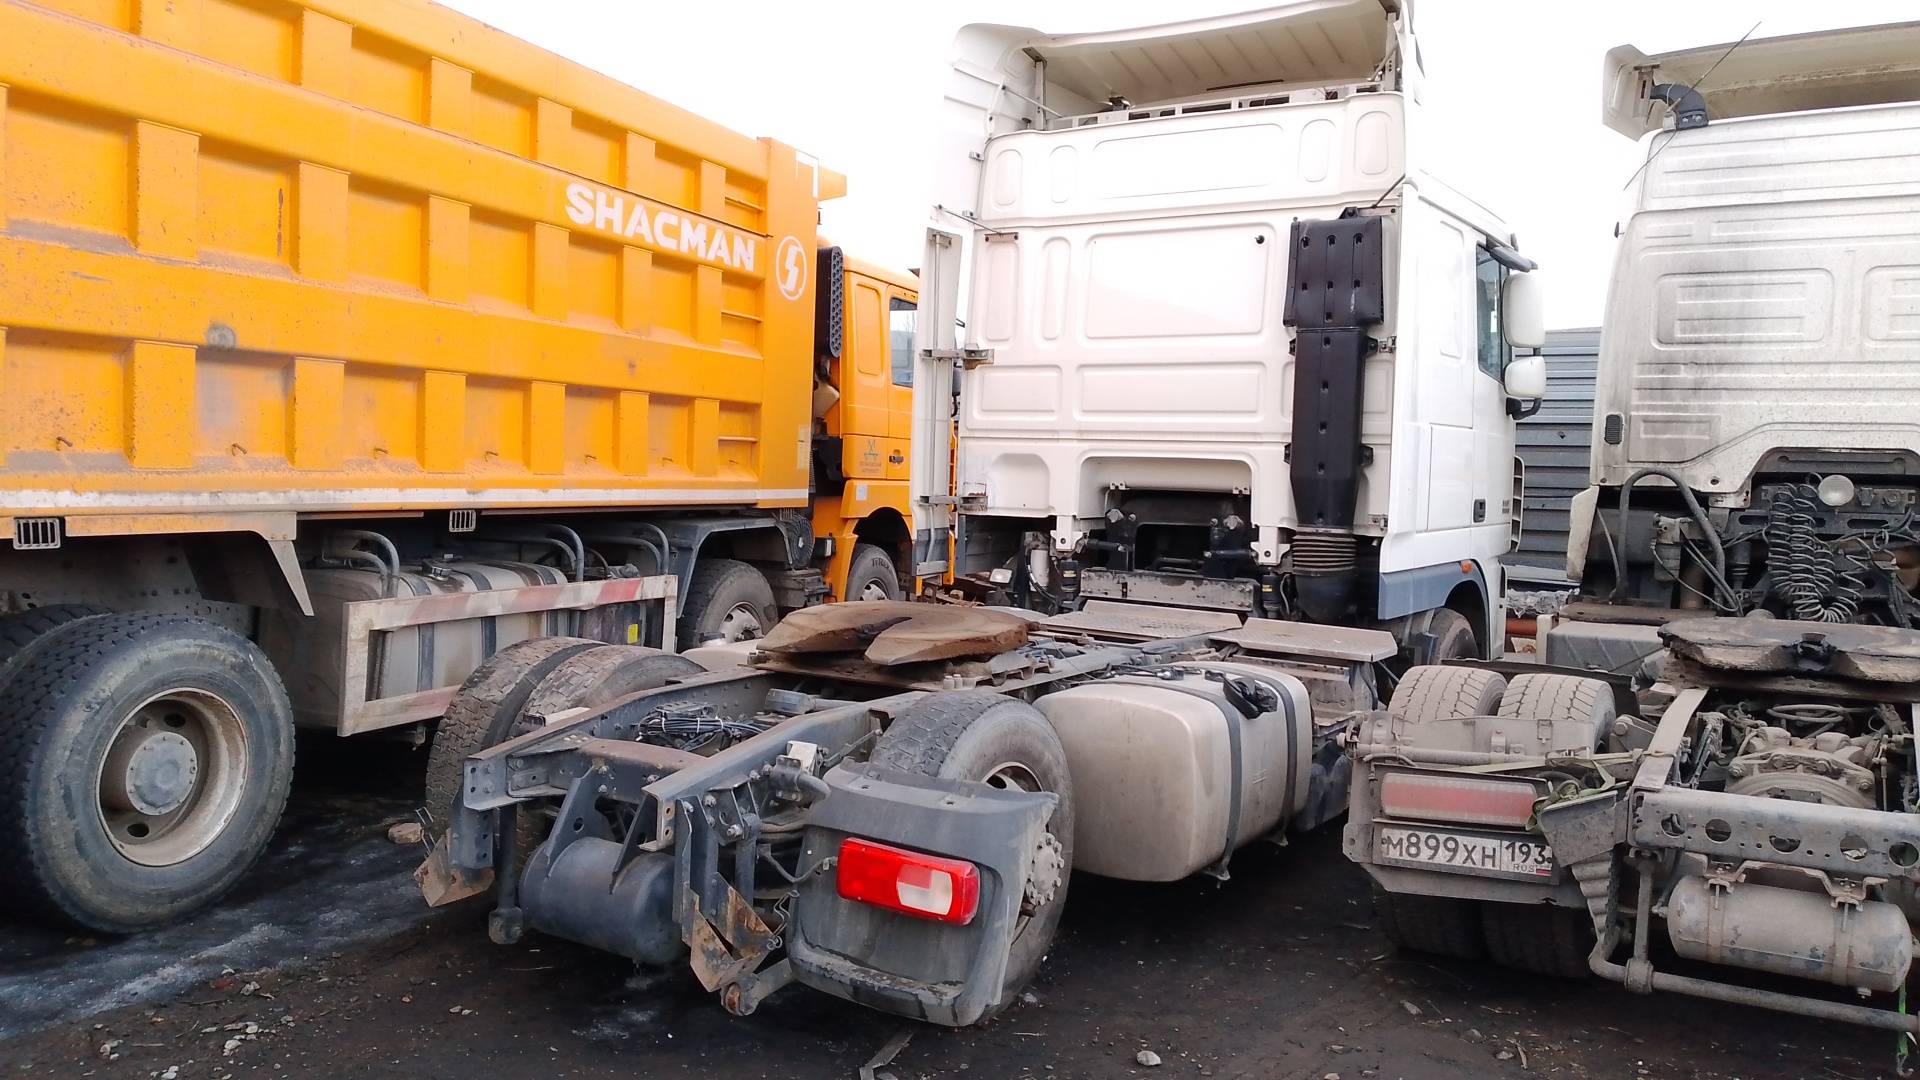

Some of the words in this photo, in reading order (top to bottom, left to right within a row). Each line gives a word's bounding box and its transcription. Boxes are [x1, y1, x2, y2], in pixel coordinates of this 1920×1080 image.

[565, 182, 756, 272] SHACMAN
[1504, 841, 1546, 865] 193
[1513, 863, 1536, 873] RUS
